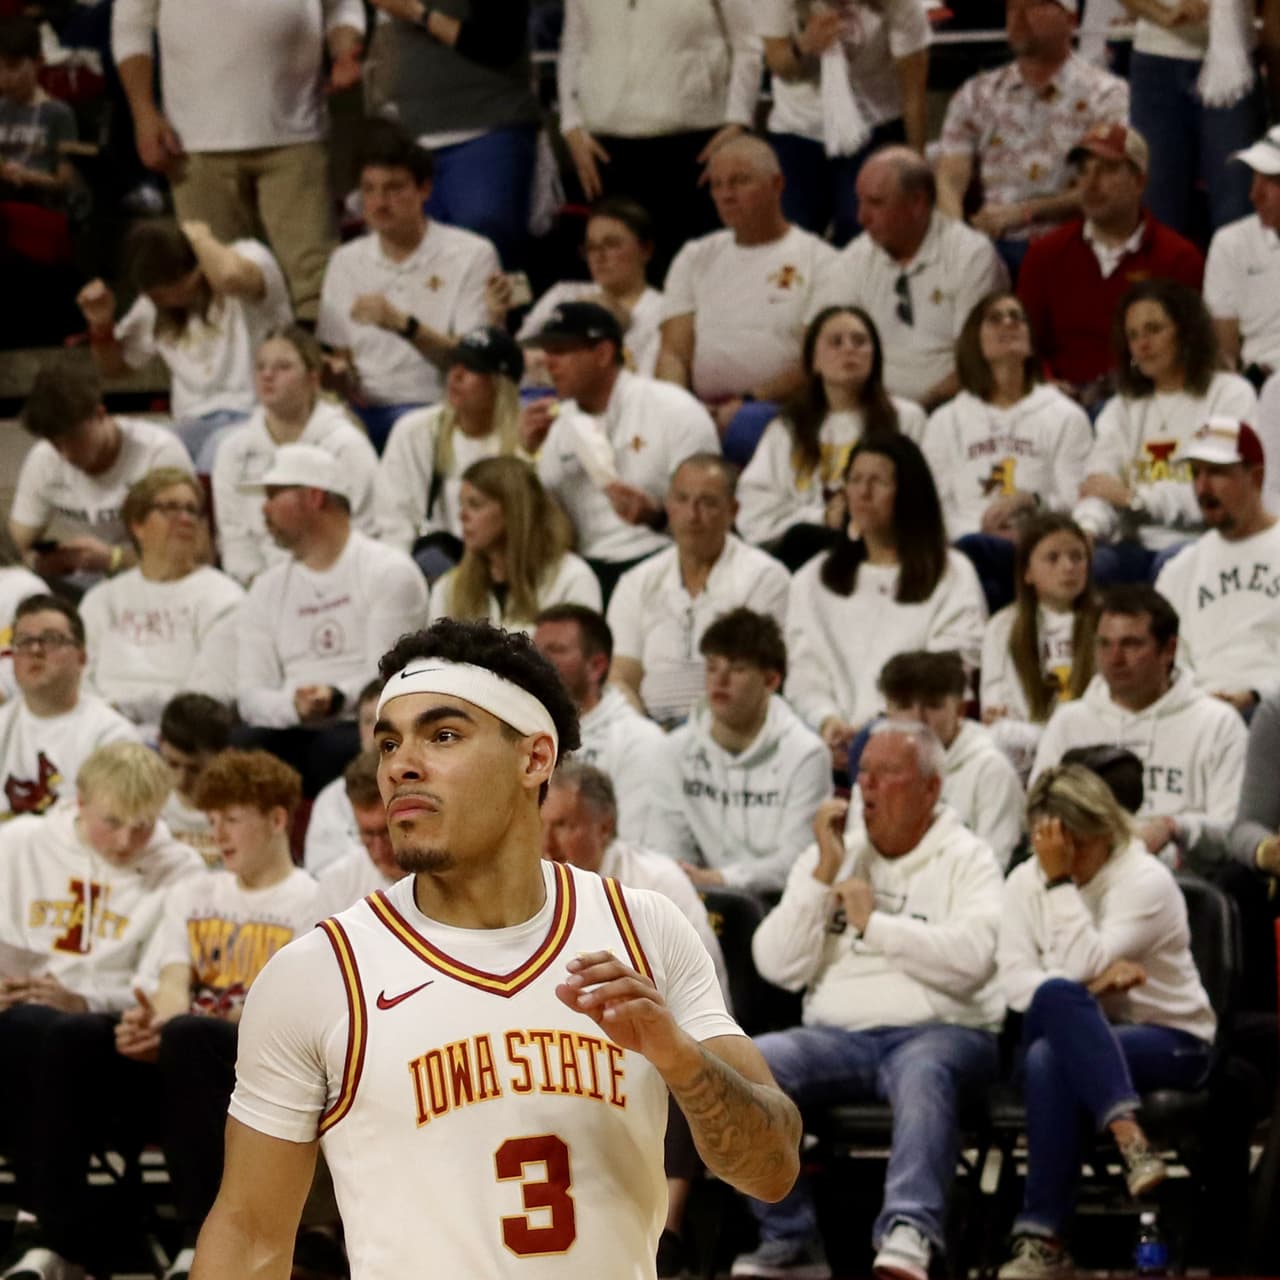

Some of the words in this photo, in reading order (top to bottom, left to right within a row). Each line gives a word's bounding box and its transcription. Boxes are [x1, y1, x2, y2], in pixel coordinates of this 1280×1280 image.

[408, 1032, 504, 1129] IOWA
[504, 1029, 628, 1111] STATE
[493, 1131, 577, 1259] 3
